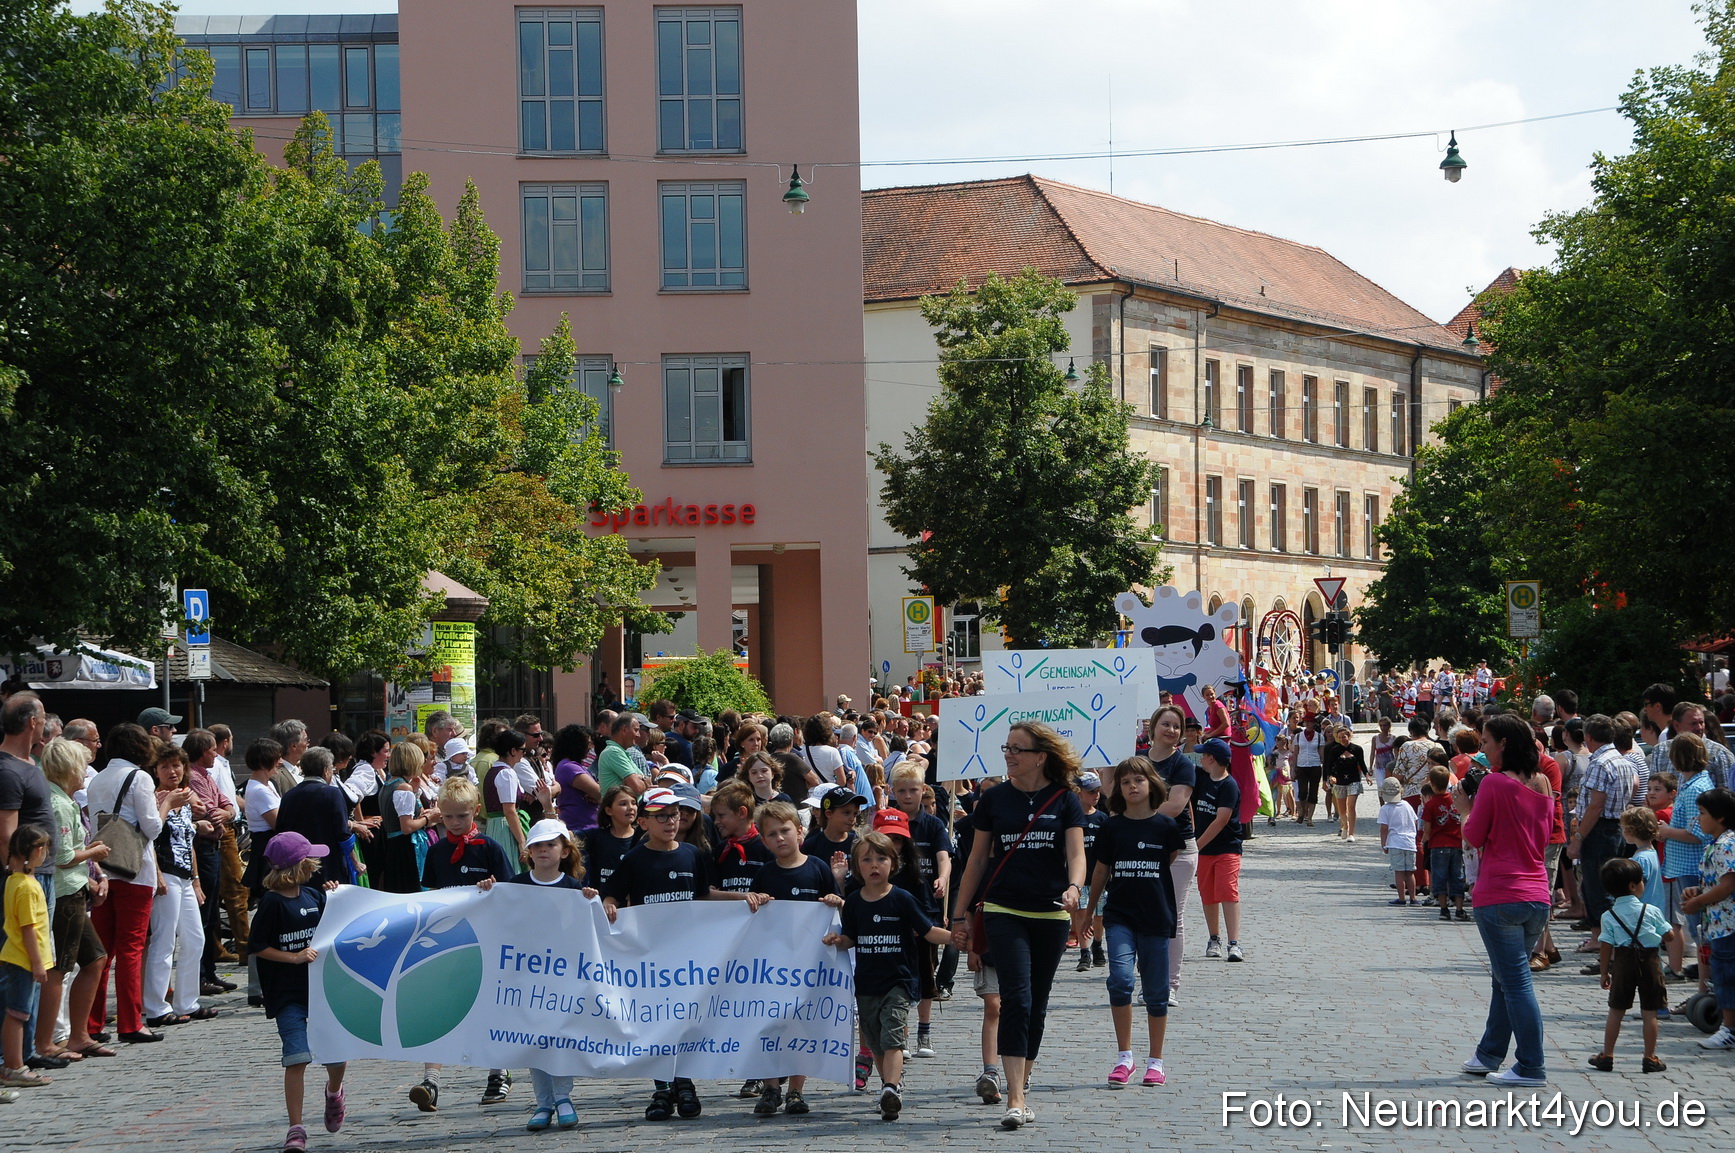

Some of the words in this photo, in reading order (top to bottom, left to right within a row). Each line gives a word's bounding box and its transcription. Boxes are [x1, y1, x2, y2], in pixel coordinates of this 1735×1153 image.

[591, 497, 756, 533] Sparkasse
[1039, 666, 1097, 680] GEMEINSAM
[1008, 708, 1074, 726] GEMEINSAM
[1114, 860, 1161, 870] GRUNDSCHULE
[289, 942, 305, 950] Haus
[500, 944, 567, 977] Freie
[577, 952, 720, 988] katholische
[496, 980, 522, 1007] im
[529, 985, 585, 1015] Haus
[489, 1028, 740, 1058] www.grundschule-neumarkt.de
[760, 1037, 783, 1052] Tel.
